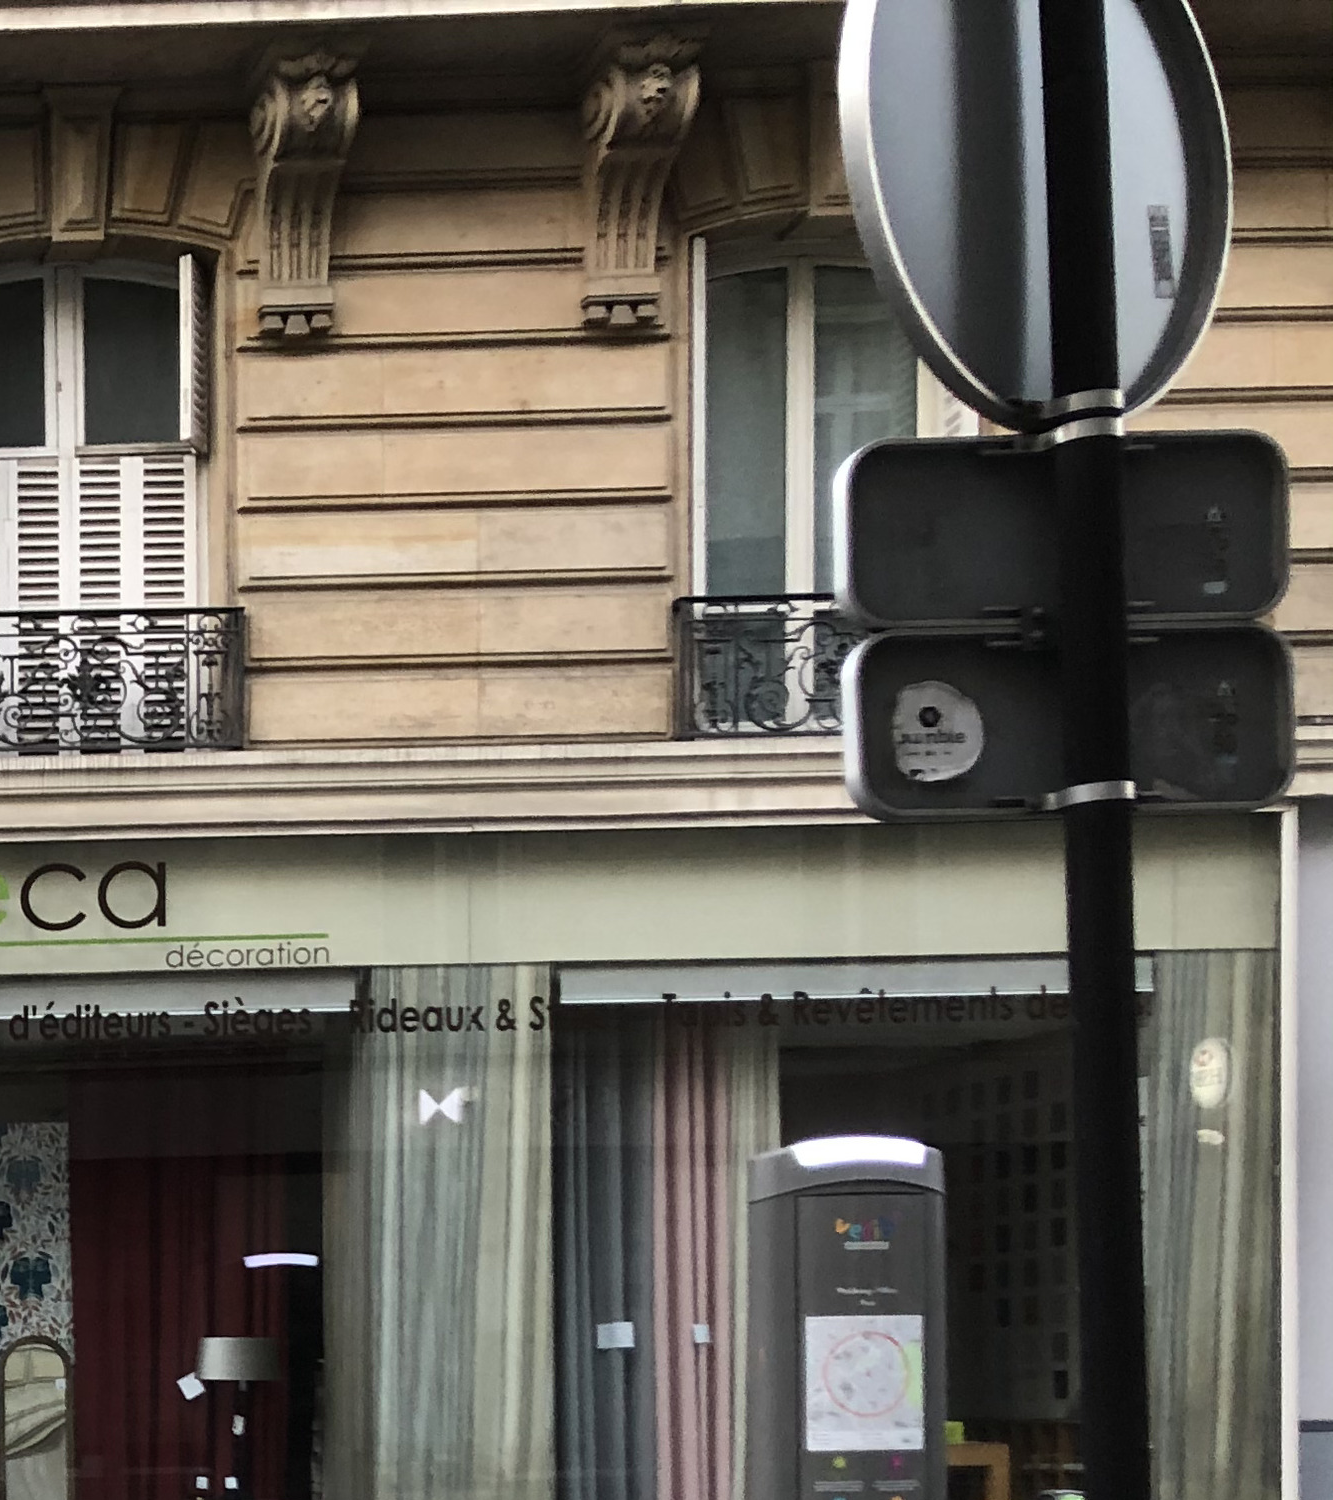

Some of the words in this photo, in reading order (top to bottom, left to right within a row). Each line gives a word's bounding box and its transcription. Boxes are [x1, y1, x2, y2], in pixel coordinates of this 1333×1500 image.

[164, 942, 330, 969] décoration
[8, 1000, 171, 1041] d'éditeurs
[203, 996, 313, 1038] Sièges
[350, 998, 486, 1034] Rideaux
[494, 997, 517, 1032] &
[757, 992, 779, 1027] &
